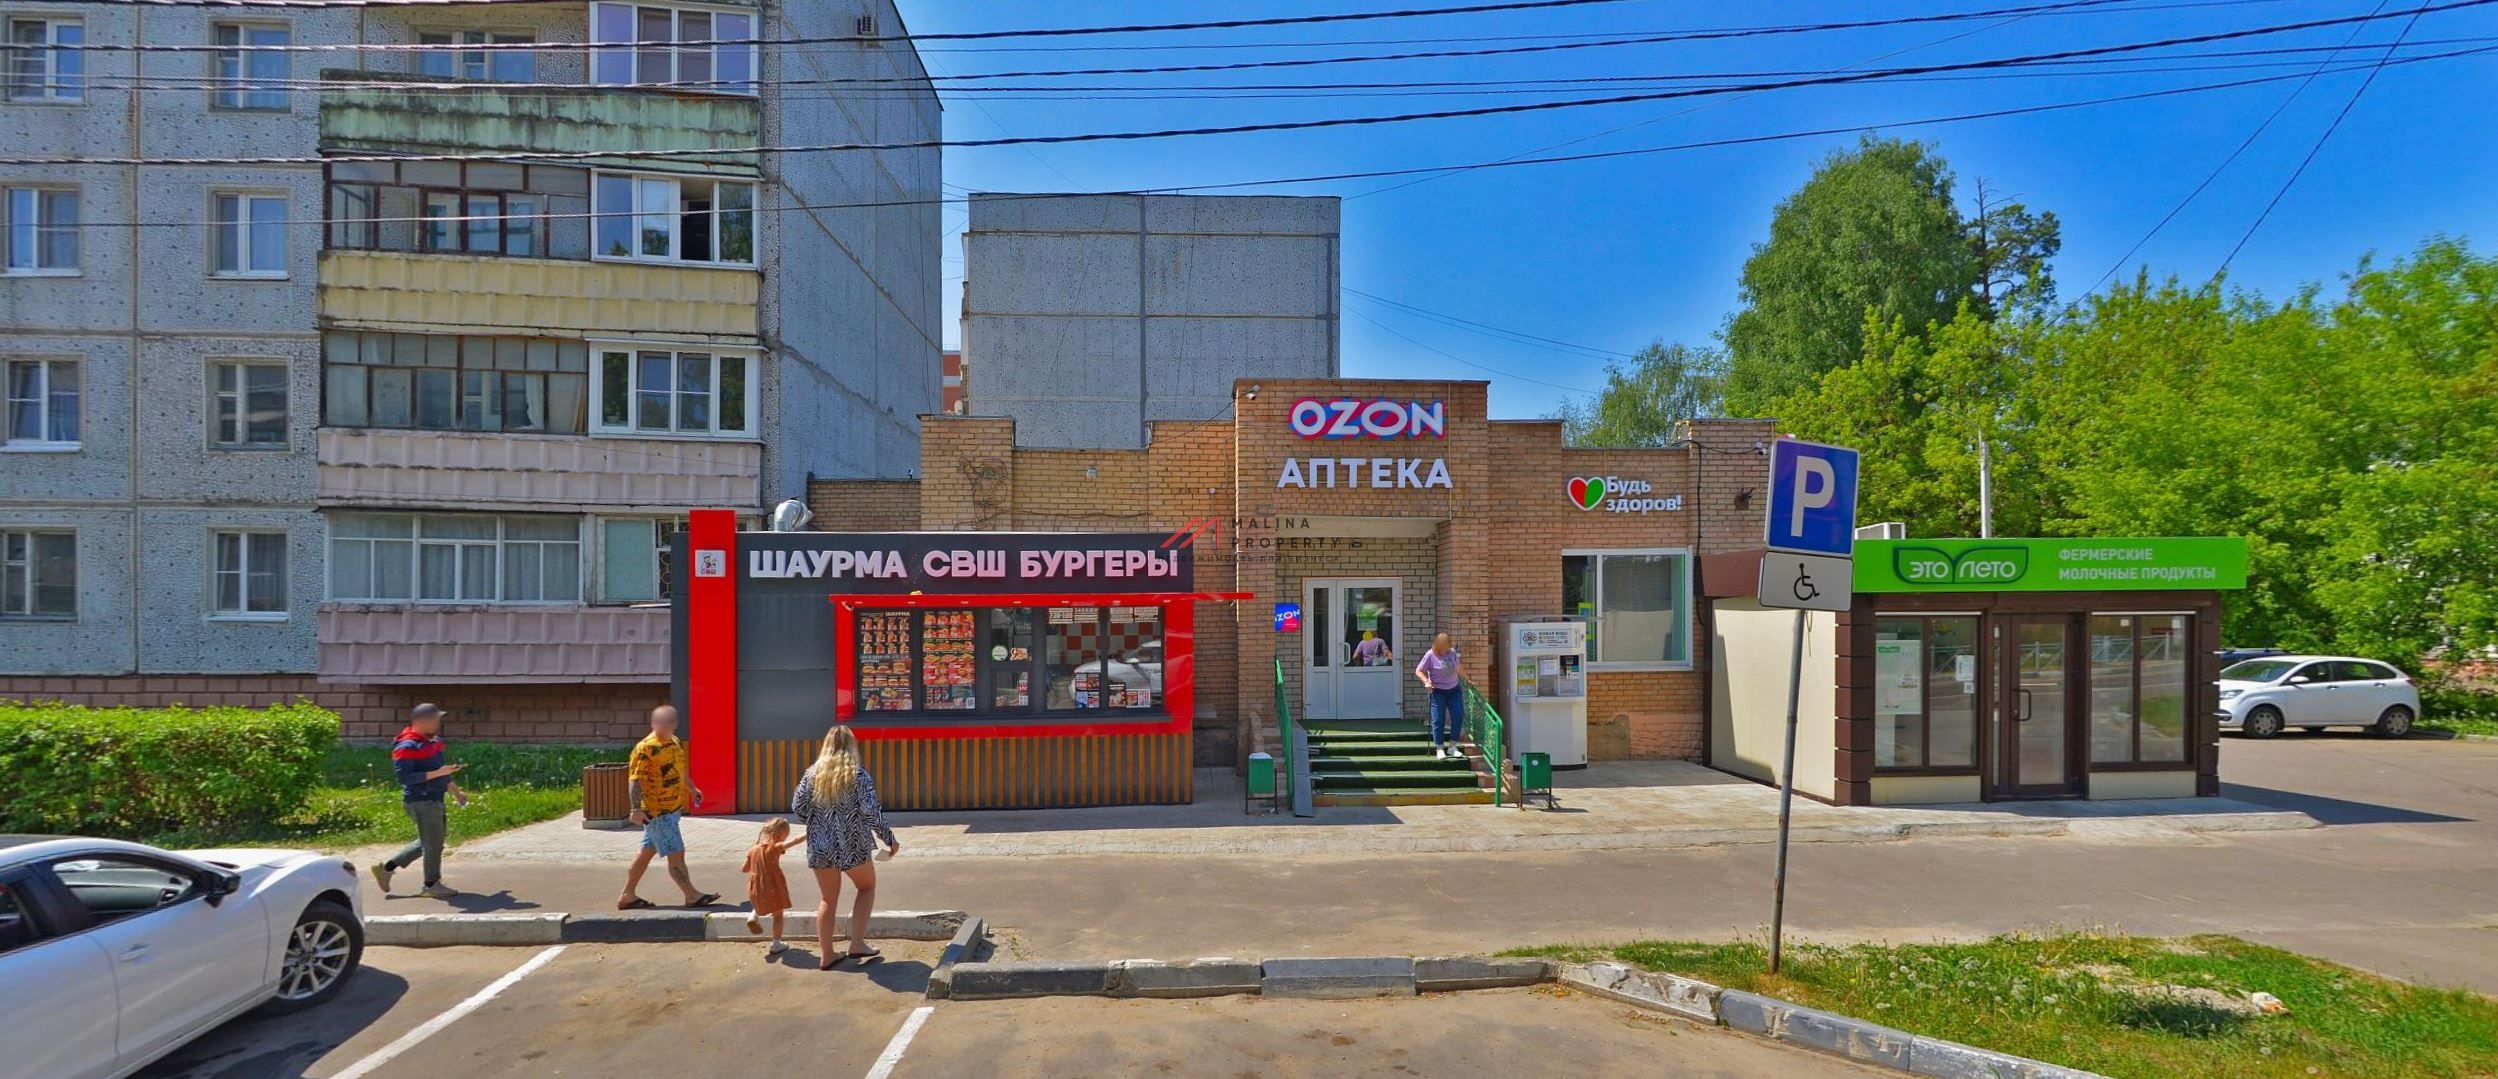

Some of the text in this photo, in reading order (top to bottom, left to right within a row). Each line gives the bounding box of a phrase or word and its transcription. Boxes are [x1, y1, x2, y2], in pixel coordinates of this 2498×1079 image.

[1292, 400, 1444, 436] OZON
[1277, 458, 1453, 488] АПТЕКА
[1606, 475, 1652, 496] Будь
[1606, 495, 1682, 513] здоров!
[1791, 456, 1835, 537] P
[749, 550, 1178, 577] ШАУРМА СВШ БУРГЕРЫ
[2059, 548, 2154, 560] ФЕРМЕРСКИЕ
[1909, 562, 1948, 578] ЭТО
[2059, 566, 2216, 580] МОЛОЧНЫЕ ПРОДУКТЫ
[1275, 609, 1299, 622] ZON
